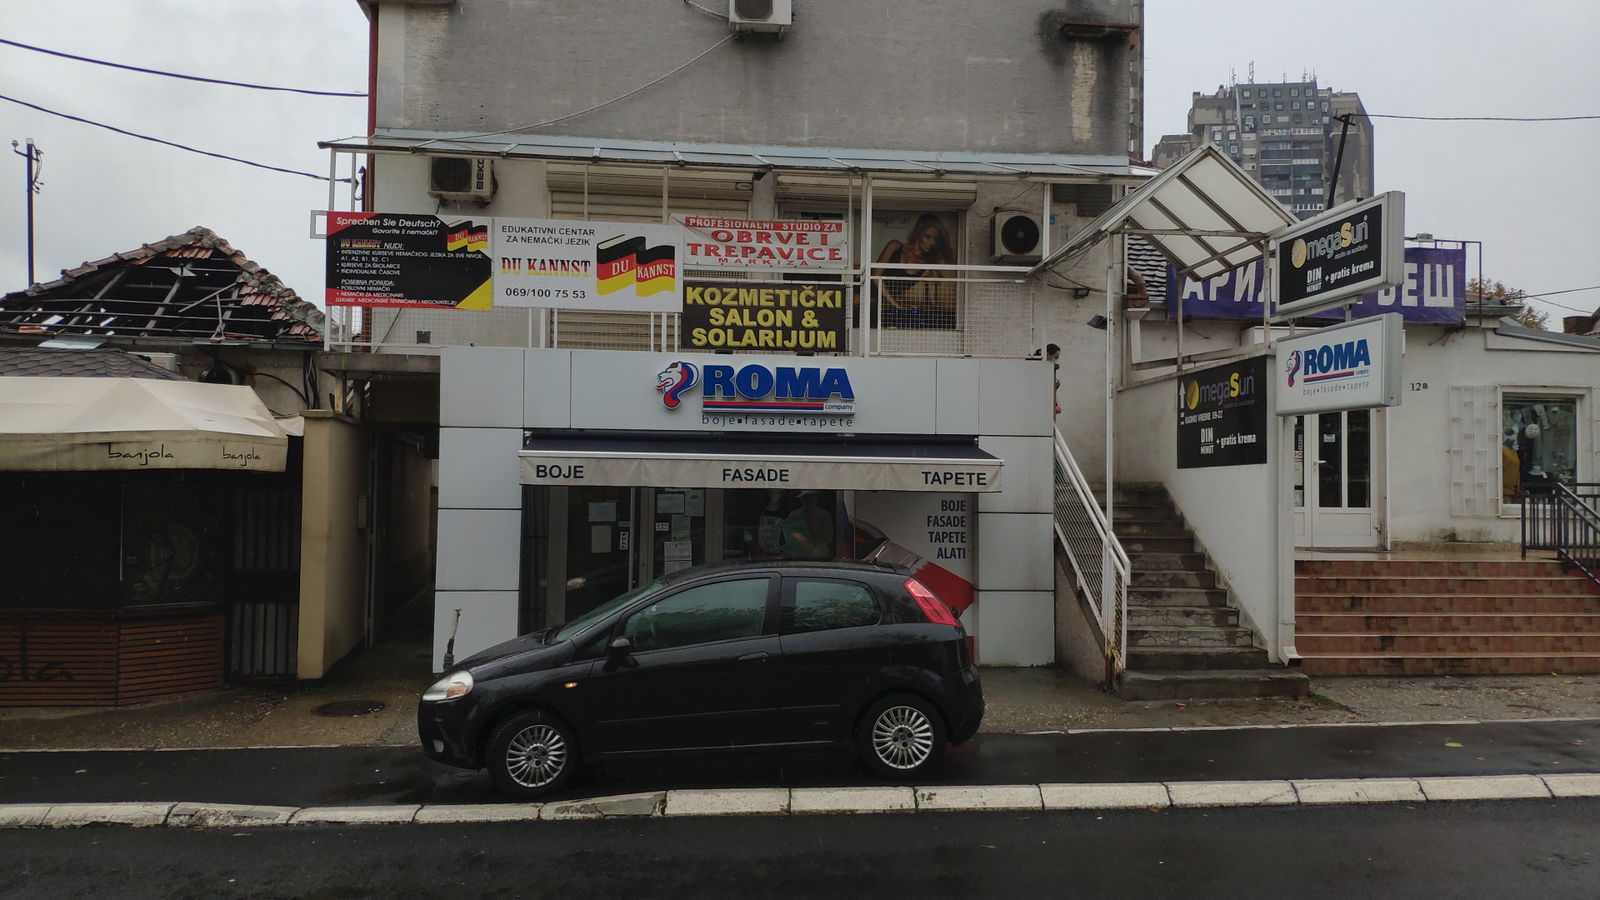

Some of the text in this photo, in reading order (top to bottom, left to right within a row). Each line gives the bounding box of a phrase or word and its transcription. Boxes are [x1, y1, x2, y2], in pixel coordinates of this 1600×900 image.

[336, 216, 441, 228] Sprechen Sie Deutsch?
[689, 218, 837, 232] PROFESIONALNI STUDIO ZA
[372, 227, 400, 235] Govorite
[501, 225, 595, 237] EDUKATIVNI CENTAR
[710, 229, 828, 246] OBRVE I
[506, 235, 591, 246] ZA NEMAČKI JEZIK
[1306, 221, 1368, 260] megaSun
[686, 243, 843, 261] TREPAVICE
[501, 257, 591, 278] DU KANNST
[611, 259, 675, 279] DU KANNST
[718, 257, 809, 266] MARKIZA
[1306, 266, 1322, 284] DIN
[1330, 266, 1350, 284] gratis
[1351, 260, 1374, 275] krema
[505, 287, 586, 299] 069/100 75 53
[1306, 281, 1322, 293] MINUT
[686, 285, 843, 309] KOZMETIČKI
[709, 308, 820, 329] SALON &
[691, 328, 837, 349] SOLARIJUM
[1304, 338, 1371, 375] ROMA
[702, 364, 855, 400] ROMA
[1199, 372, 1255, 406] megaSun
[1410, 382, 1429, 392] 12a
[825, 403, 853, 412] company
[702, 415, 853, 428] boje fasade tapete
[1200, 427, 1213, 443] DIN
[1220, 433, 1237, 449] gratis
[1237, 432, 1256, 445] krema
[107, 442, 175, 466] banjola
[222, 445, 261, 466] banjola
[535, 464, 987, 487] BOJE FASADE TAPETE
[941, 499, 966, 512] BOJE
[927, 515, 966, 528] FASADE
[928, 531, 966, 544] TAPETE
[936, 547, 966, 559] ALATI
